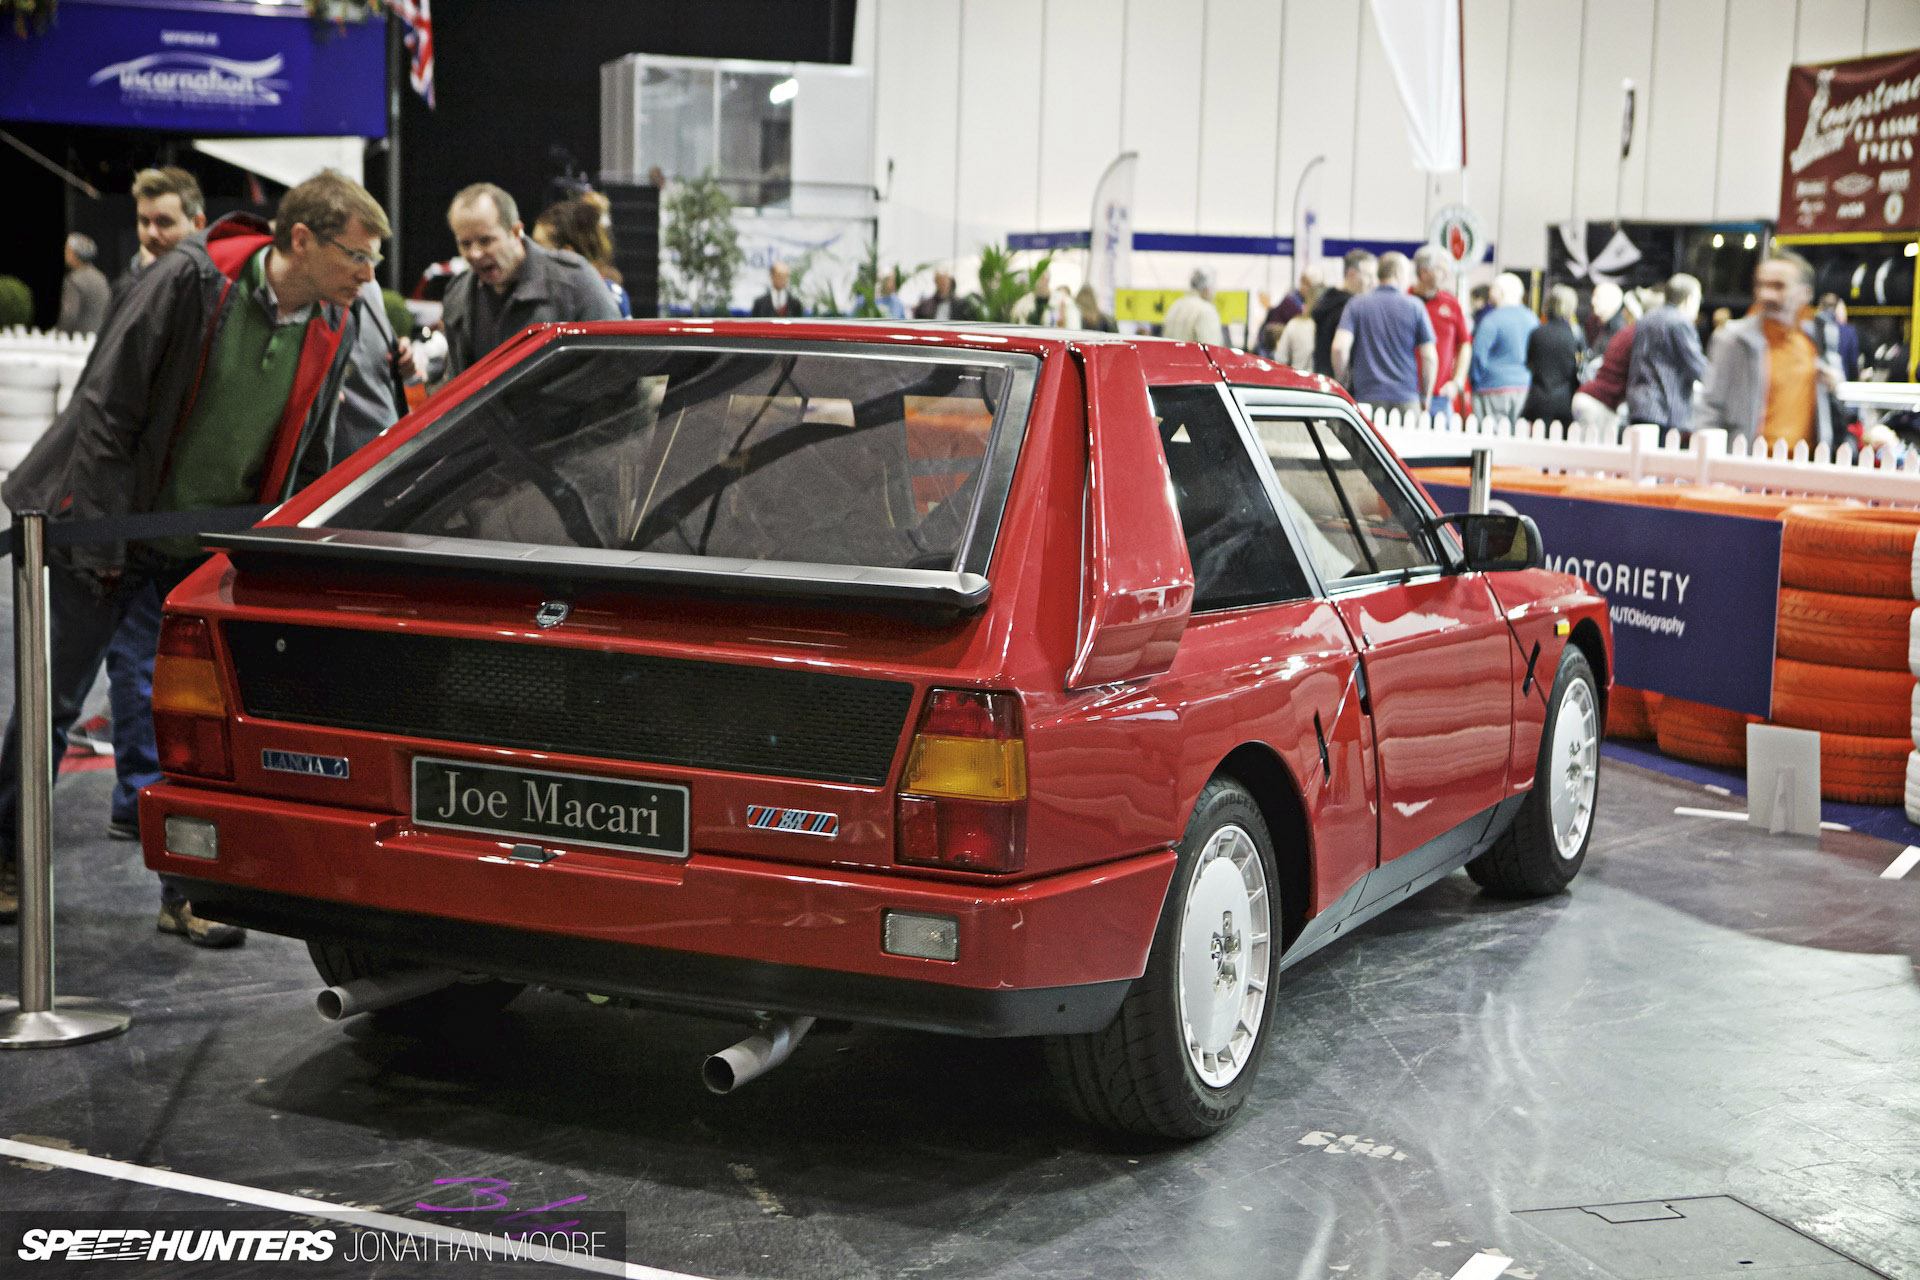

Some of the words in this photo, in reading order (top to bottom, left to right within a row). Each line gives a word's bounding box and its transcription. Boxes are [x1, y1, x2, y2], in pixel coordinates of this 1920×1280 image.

[1545, 553, 1690, 604] MOTORIETY
[438, 770, 508, 818] Joe
[522, 780, 660, 837] Macari
